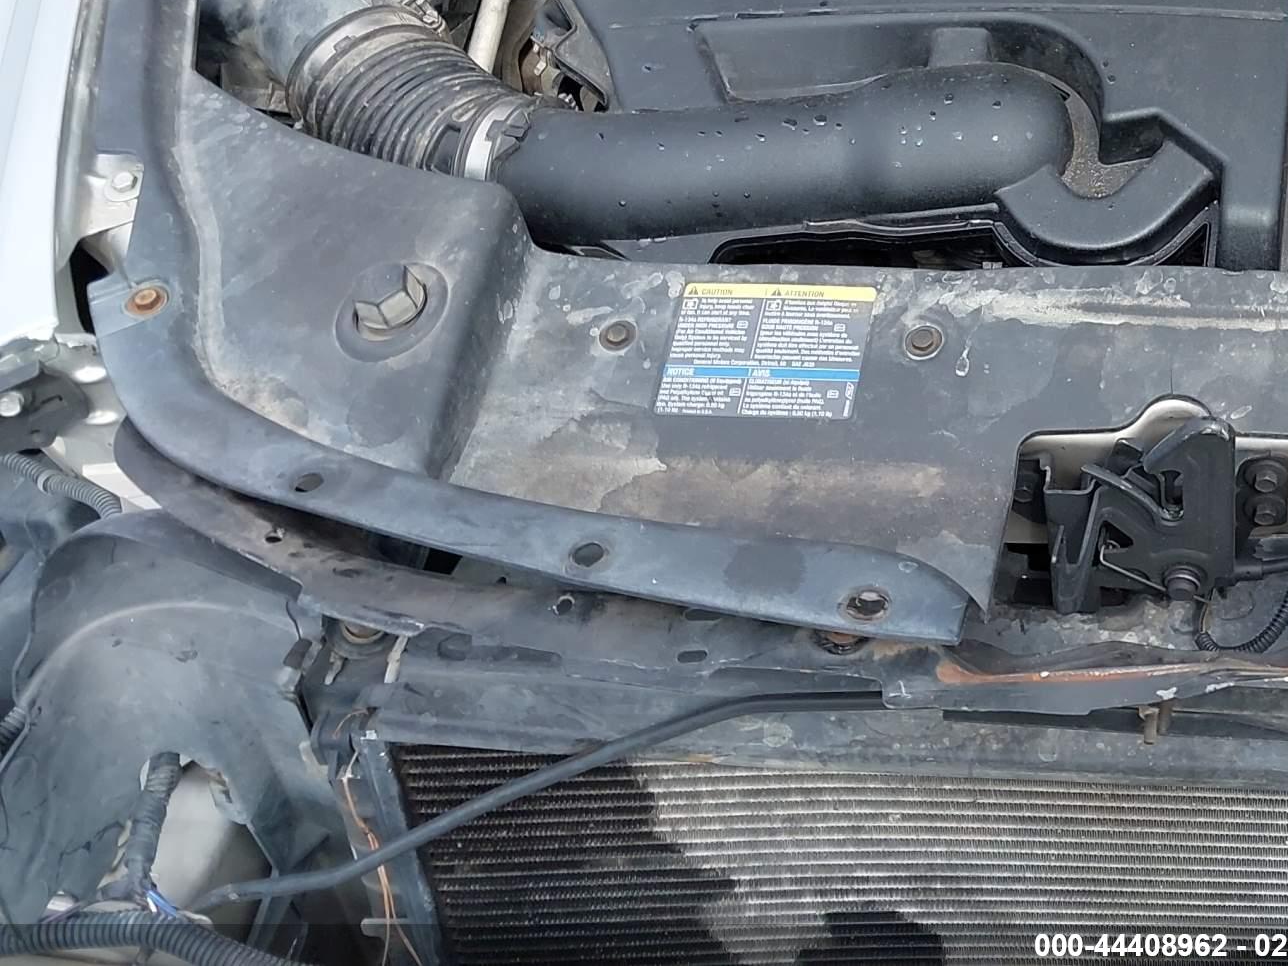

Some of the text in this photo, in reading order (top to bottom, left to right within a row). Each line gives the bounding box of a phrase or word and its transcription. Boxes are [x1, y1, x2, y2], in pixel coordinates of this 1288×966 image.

[701, 288, 733, 296] CAUTION
[784, 290, 825, 298] ATTENTION
[666, 367, 694, 378] NOTICE
[752, 369, 771, 378] AVIS
